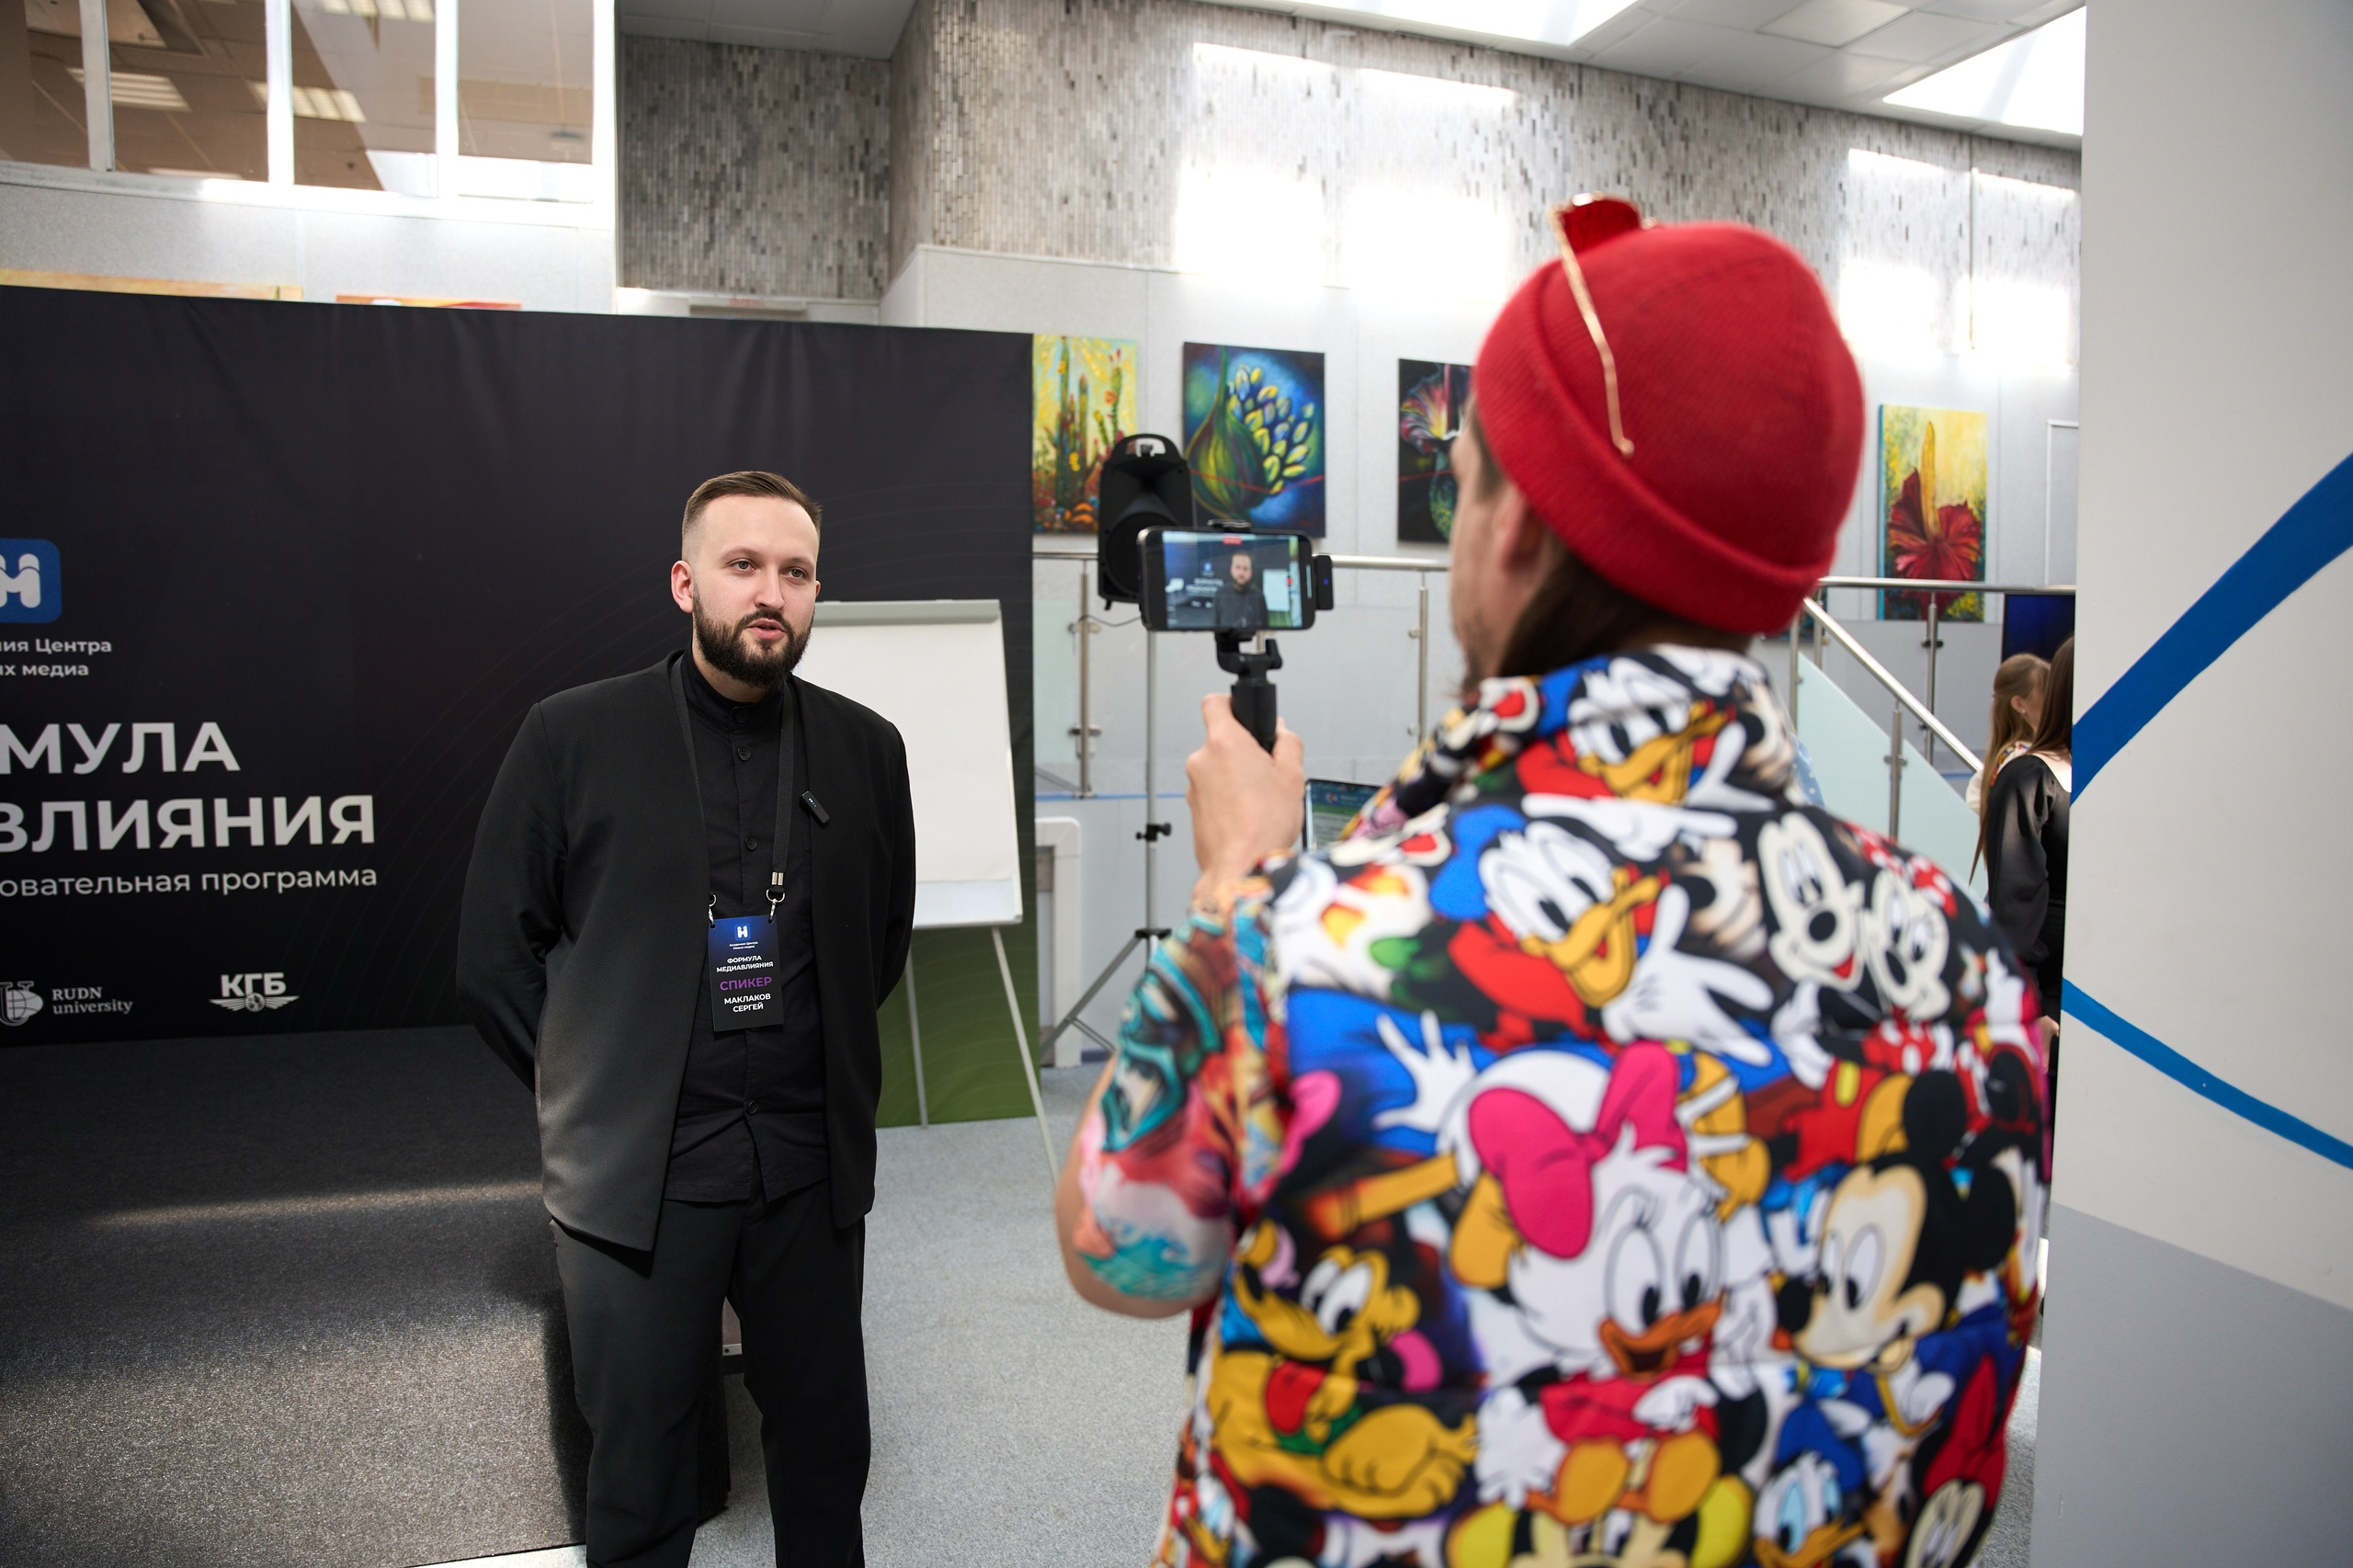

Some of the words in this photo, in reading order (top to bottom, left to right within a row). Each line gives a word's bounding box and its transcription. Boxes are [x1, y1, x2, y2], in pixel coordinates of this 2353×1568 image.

[0, 640, 29, 653] ия
[35, 638, 113, 655] Центра
[22, 664, 90, 677] медиа
[0, 722, 242, 775] МУЛА
[0, 794, 375, 853] ВЛИЯНИЯ
[0, 873, 191, 897] овательная
[200, 868, 378, 895] программа
[716, 961, 773, 972] МЕДИАВЛИЯНИЯ
[727, 955, 762, 963] ФОРМУЛА
[221, 971, 287, 997] КГБ
[720, 976, 772, 991] СПИКЕР
[51, 986, 103, 1002] RUDN
[723, 993, 771, 1005] МАКЛАКОВ
[52, 998, 134, 1015] university
[733, 1002, 764, 1013] СЕРГЕЙ
